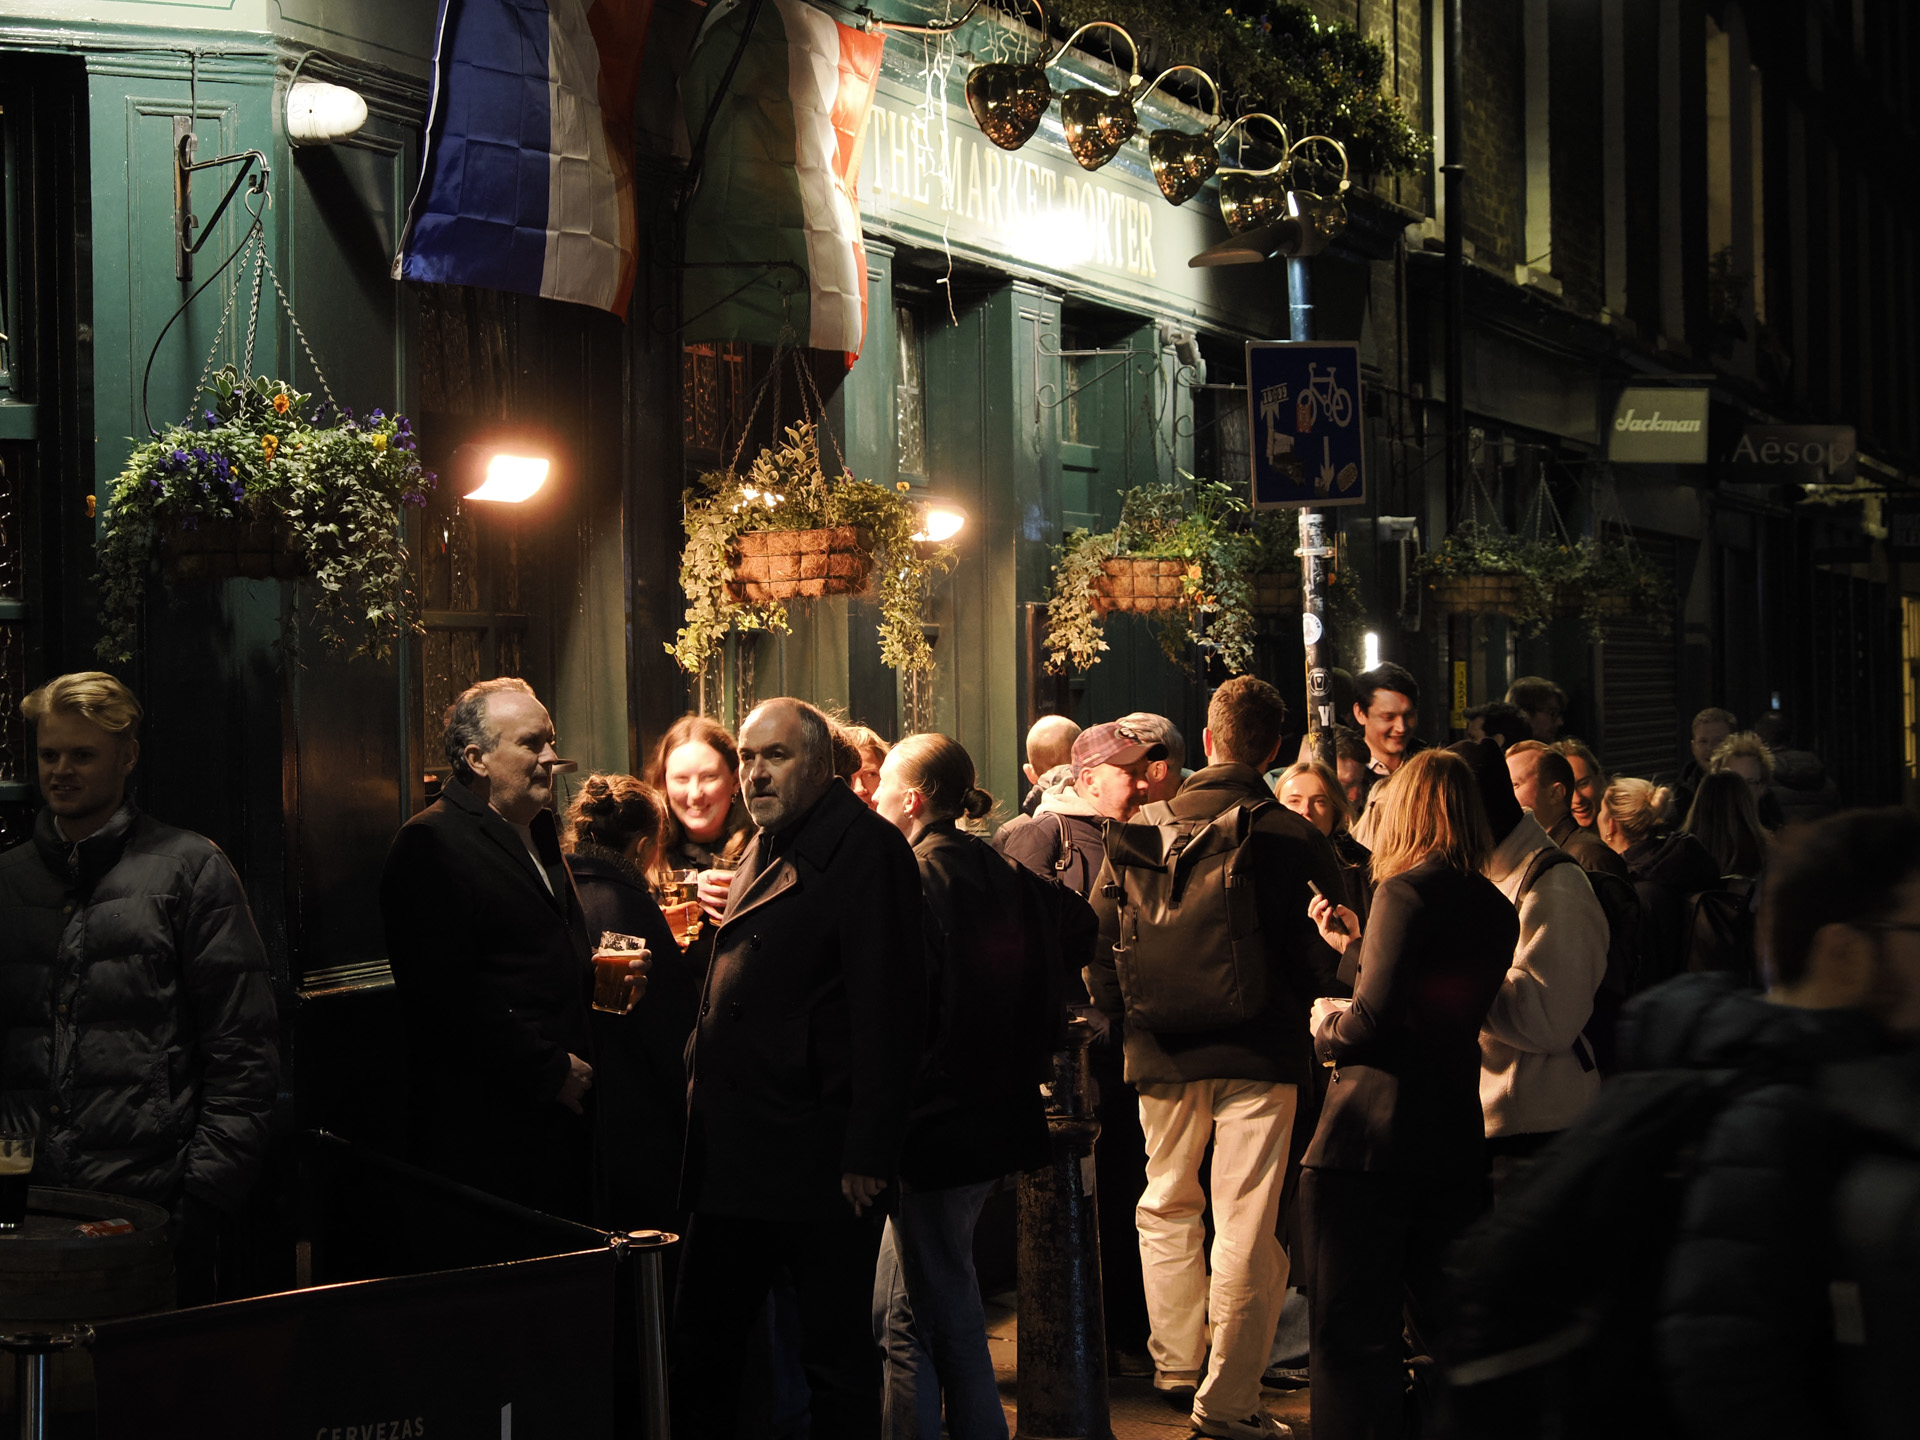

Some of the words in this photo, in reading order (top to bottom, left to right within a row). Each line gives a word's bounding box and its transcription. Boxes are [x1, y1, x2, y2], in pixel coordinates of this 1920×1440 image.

[868, 104, 930, 205] THE
[940, 131, 1057, 236] MARKET
[1614, 408, 1702, 434] Jackman
[316, 1416, 425, 1440] CERVEZAS
